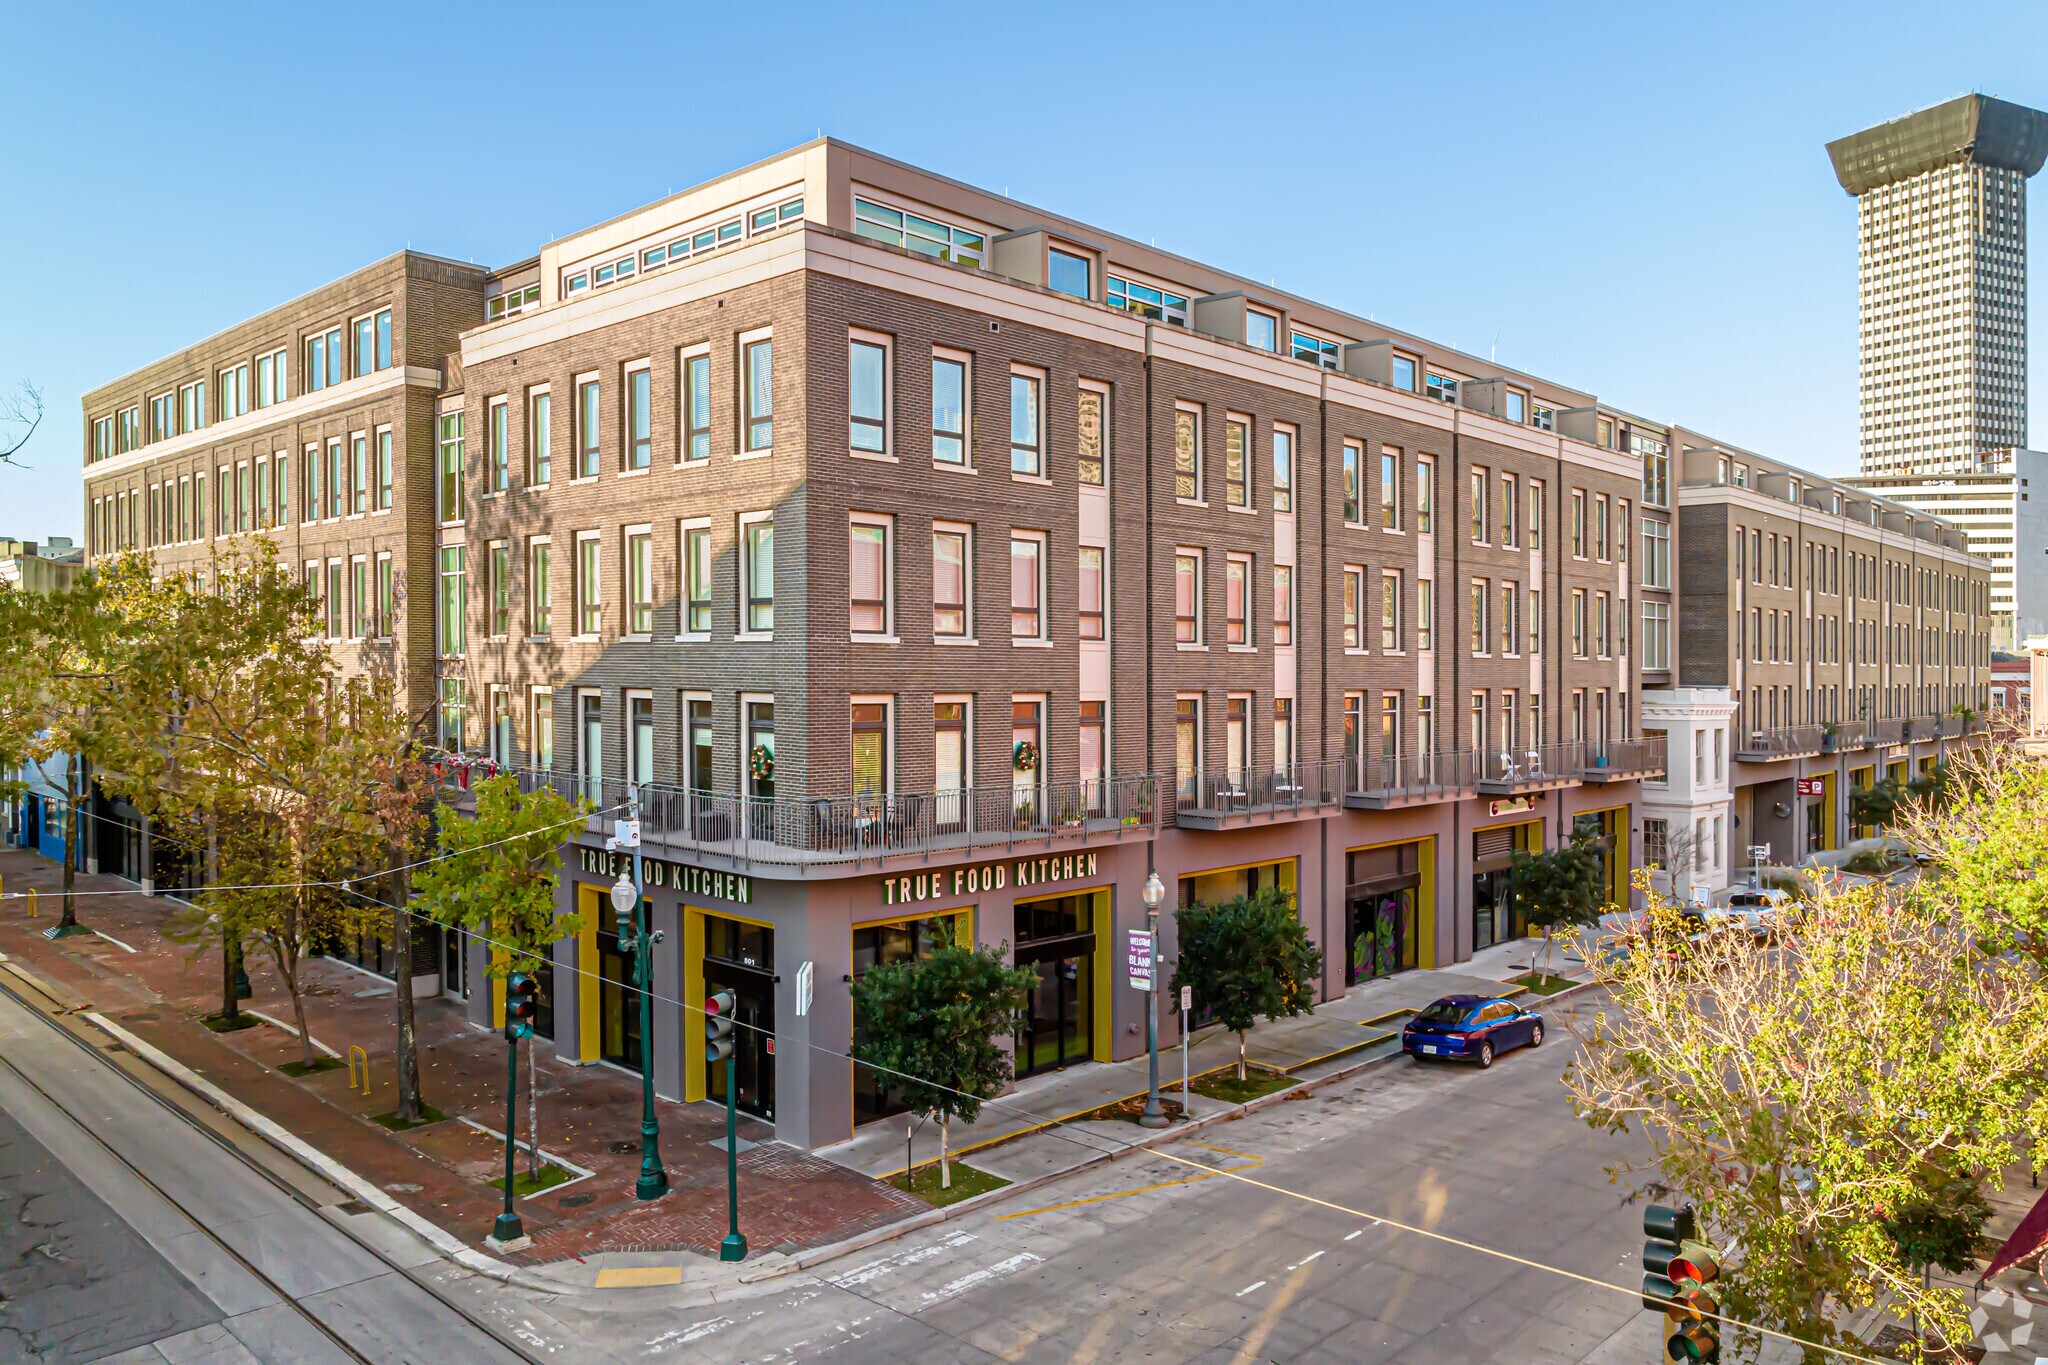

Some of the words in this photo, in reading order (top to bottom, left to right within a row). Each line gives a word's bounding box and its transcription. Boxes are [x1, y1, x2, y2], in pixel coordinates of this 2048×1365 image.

[580, 848, 616, 877] TRUE
[625, 856, 663, 886] FOD
[673, 865, 747, 903] KITCHEN
[884, 873, 941, 904] TRUE
[954, 864, 1006, 895] FOOD
[1017, 853, 1097, 886] KITCHEN
